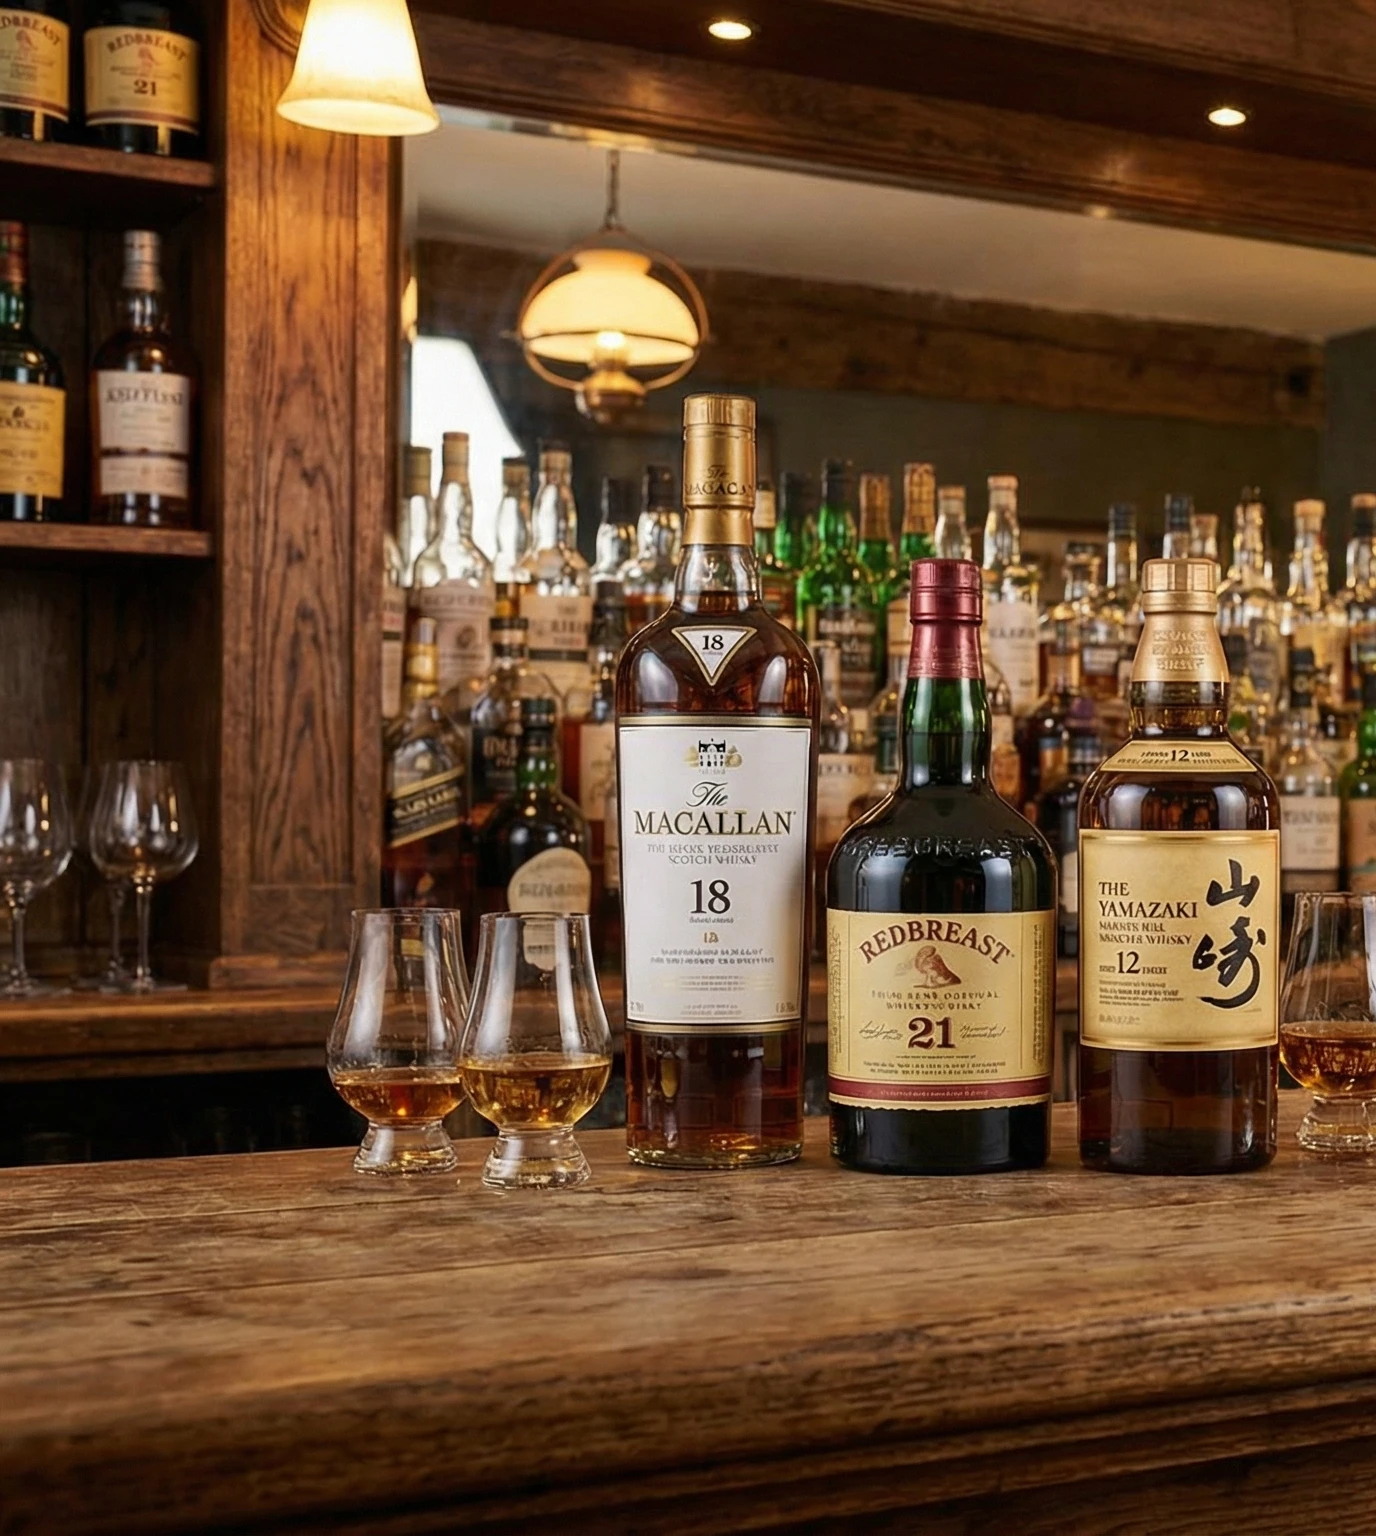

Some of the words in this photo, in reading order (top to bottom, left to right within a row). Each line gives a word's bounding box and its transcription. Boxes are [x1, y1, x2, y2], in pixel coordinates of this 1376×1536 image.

[133, 80, 157, 96] 21
[702, 634, 725, 650] 18
[1170, 749, 1190, 762] 12
[686, 781, 729, 807] The
[633, 810, 793, 836] MACALLAN
[690, 879, 732, 915] 18
[1098, 882, 1131, 897] THE
[1098, 900, 1199, 919] YAMAZAKI
[858, 919, 1011, 965] REDBREAST
[1115, 950, 1142, 975] 12
[907, 1016, 956, 1049] 21
